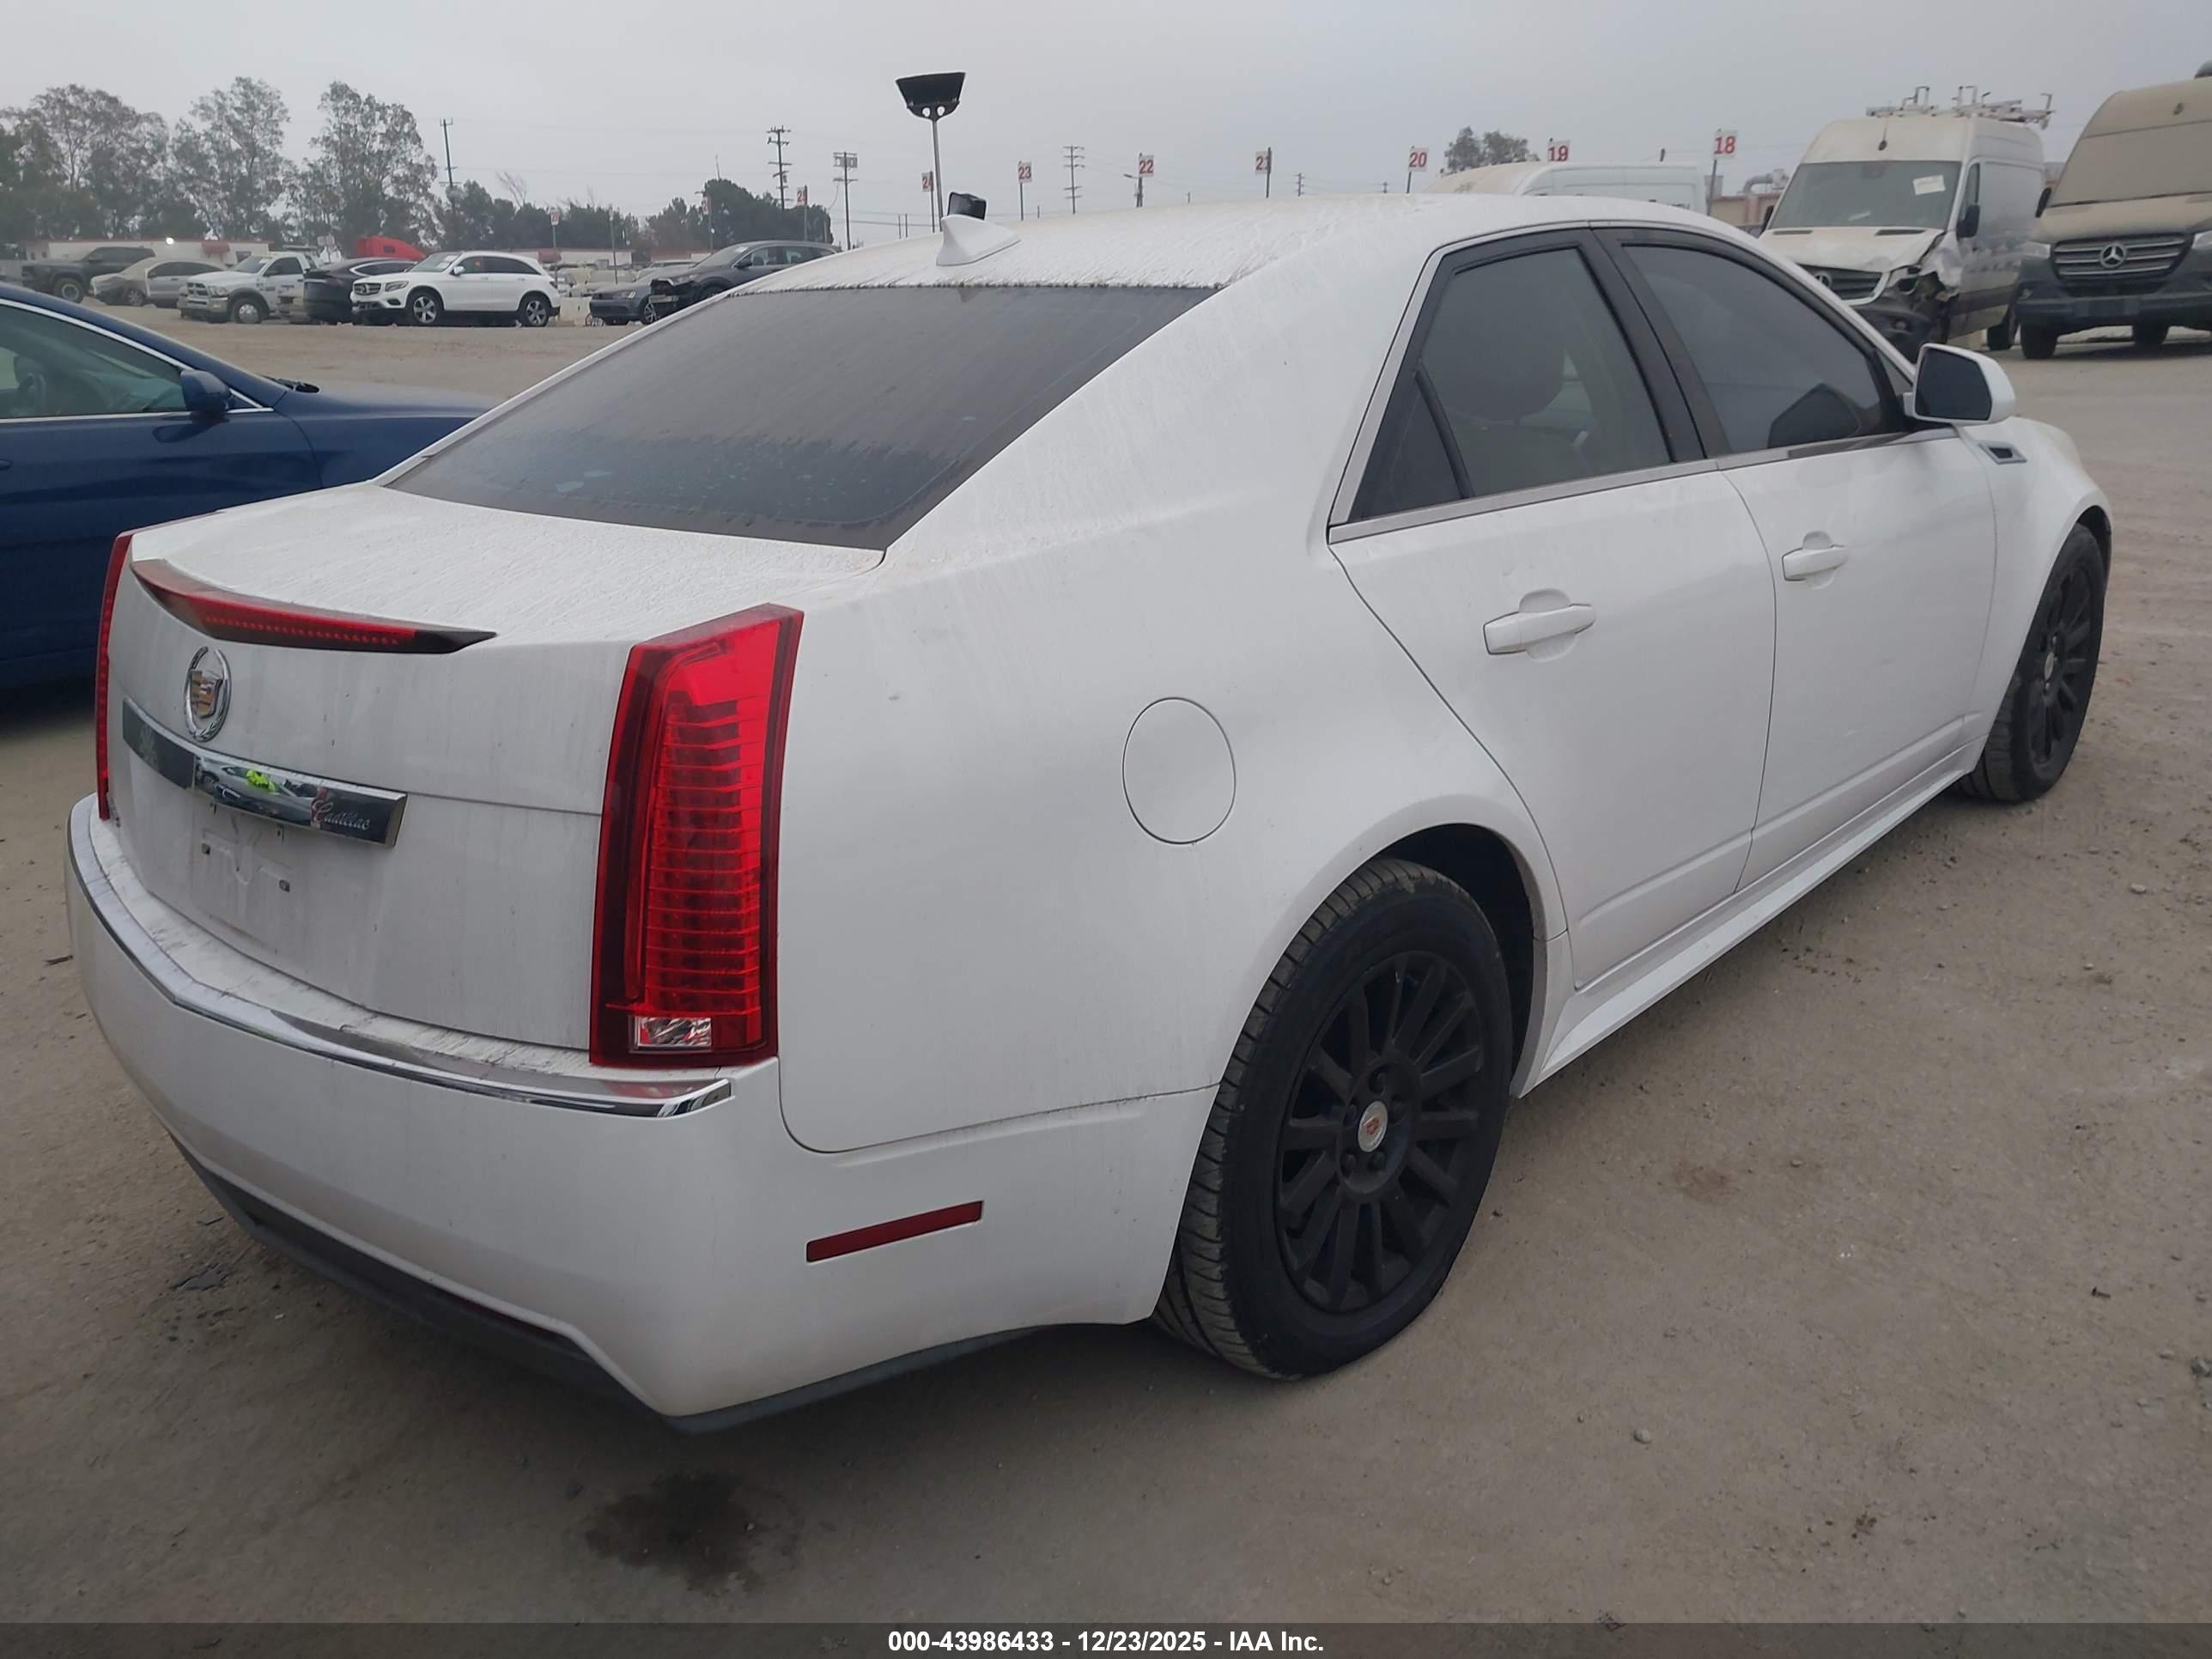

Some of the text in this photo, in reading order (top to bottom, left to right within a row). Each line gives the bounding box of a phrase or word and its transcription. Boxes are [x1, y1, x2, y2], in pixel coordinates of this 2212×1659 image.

[1548, 145, 1568, 161] 19
[1714, 136, 1735, 155] 18
[1139, 160, 1154, 174] 22
[1409, 152, 1427, 167] 20
[1018, 166, 1031, 179] 23
[311, 799, 371, 830] Cadillac
